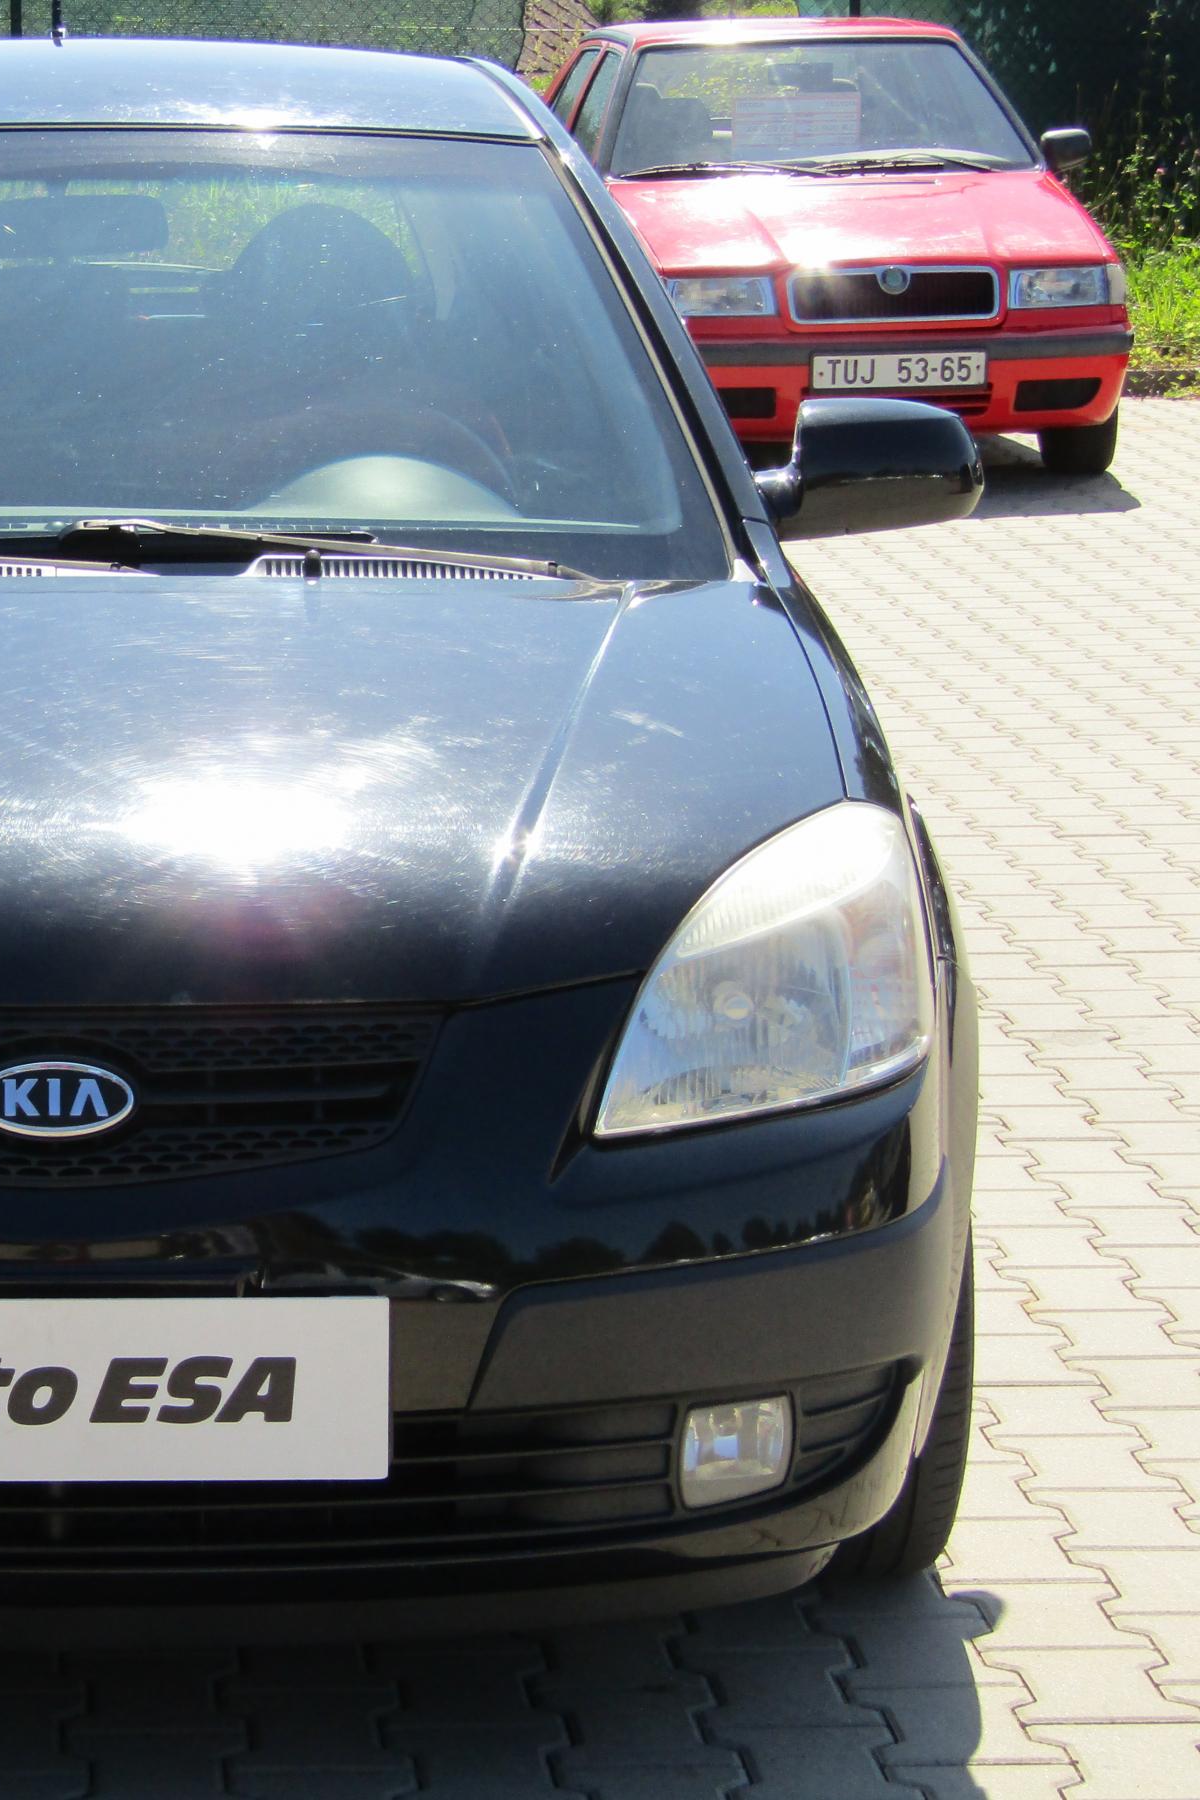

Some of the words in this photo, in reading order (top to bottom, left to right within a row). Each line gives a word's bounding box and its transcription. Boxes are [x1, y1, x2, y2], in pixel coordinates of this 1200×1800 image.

[827, 358, 876, 386] TUJ
[897, 355, 973, 384] 53-65
[2, 1078, 109, 1117] KIA
[89, 1356, 297, 1424] ESA
